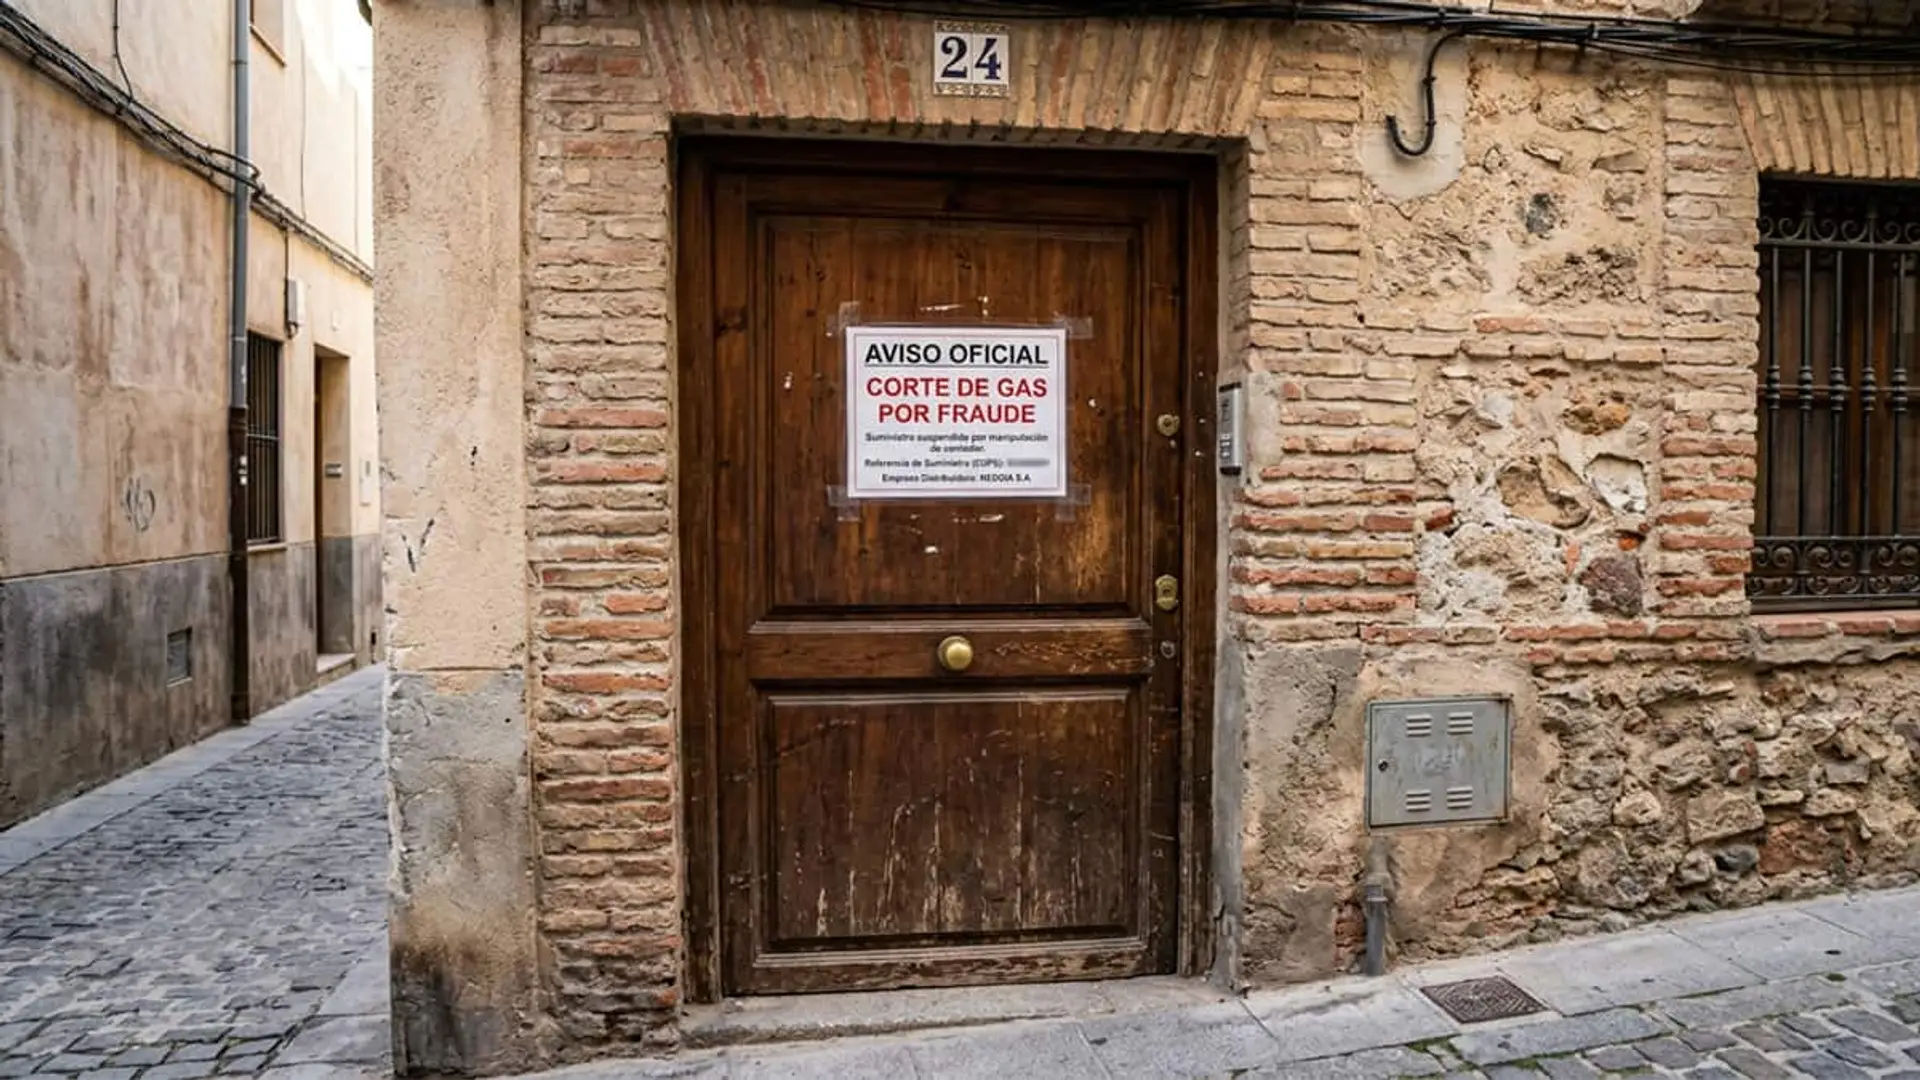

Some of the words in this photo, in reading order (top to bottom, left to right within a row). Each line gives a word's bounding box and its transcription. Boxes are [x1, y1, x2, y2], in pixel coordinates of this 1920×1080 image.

[940, 36, 1001, 80] 24
[865, 343, 942, 364] AVISO
[949, 344, 1049, 365] OFICIAL
[866, 377, 950, 397] CORTE
[957, 378, 989, 397] DE
[997, 378, 1048, 398] GAS
[878, 404, 931, 423] POR
[937, 404, 1036, 424] FRAUDE
[929, 444, 942, 453] de
[971, 434, 986, 444] por
[911, 459, 923, 468] de
